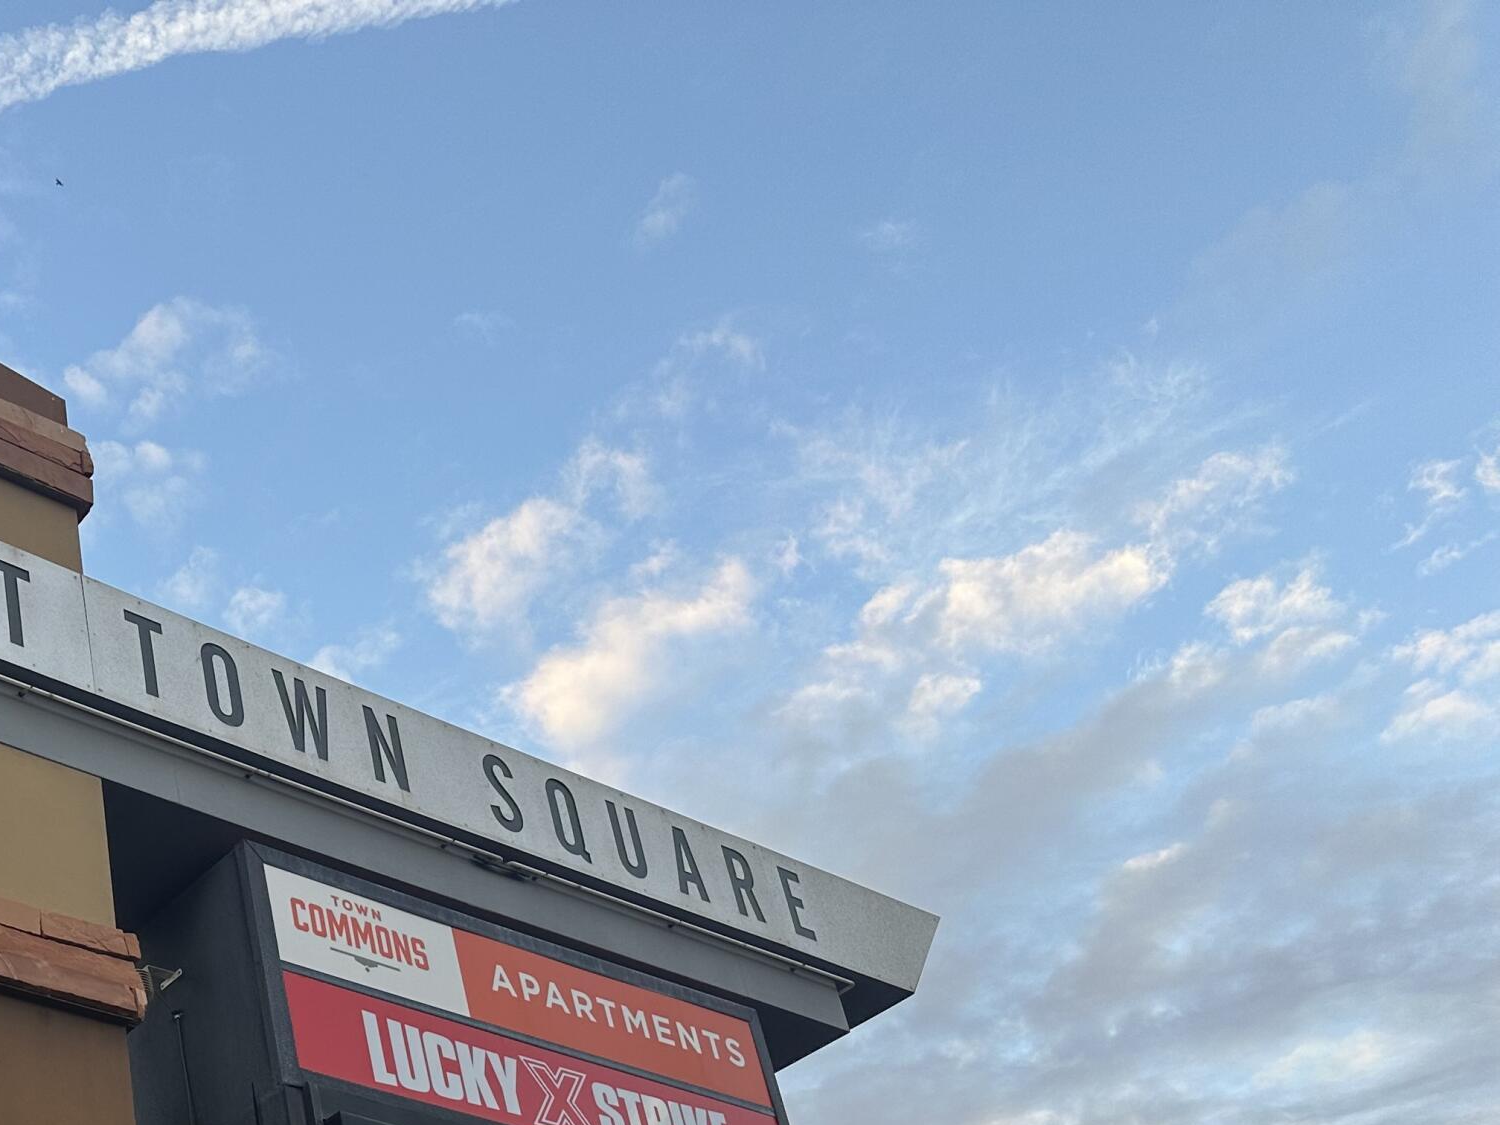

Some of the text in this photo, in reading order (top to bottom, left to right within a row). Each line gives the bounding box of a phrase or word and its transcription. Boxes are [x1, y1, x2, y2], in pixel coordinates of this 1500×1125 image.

[124, 609, 410, 792] TOWN
[482, 754, 817, 941] SQUARE
[290, 897, 429, 971] COMMONS
[331, 895, 381, 921] TOWN
[361, 1010, 521, 1115] LUCKY
[492, 964, 745, 1067] APARTMENTS
